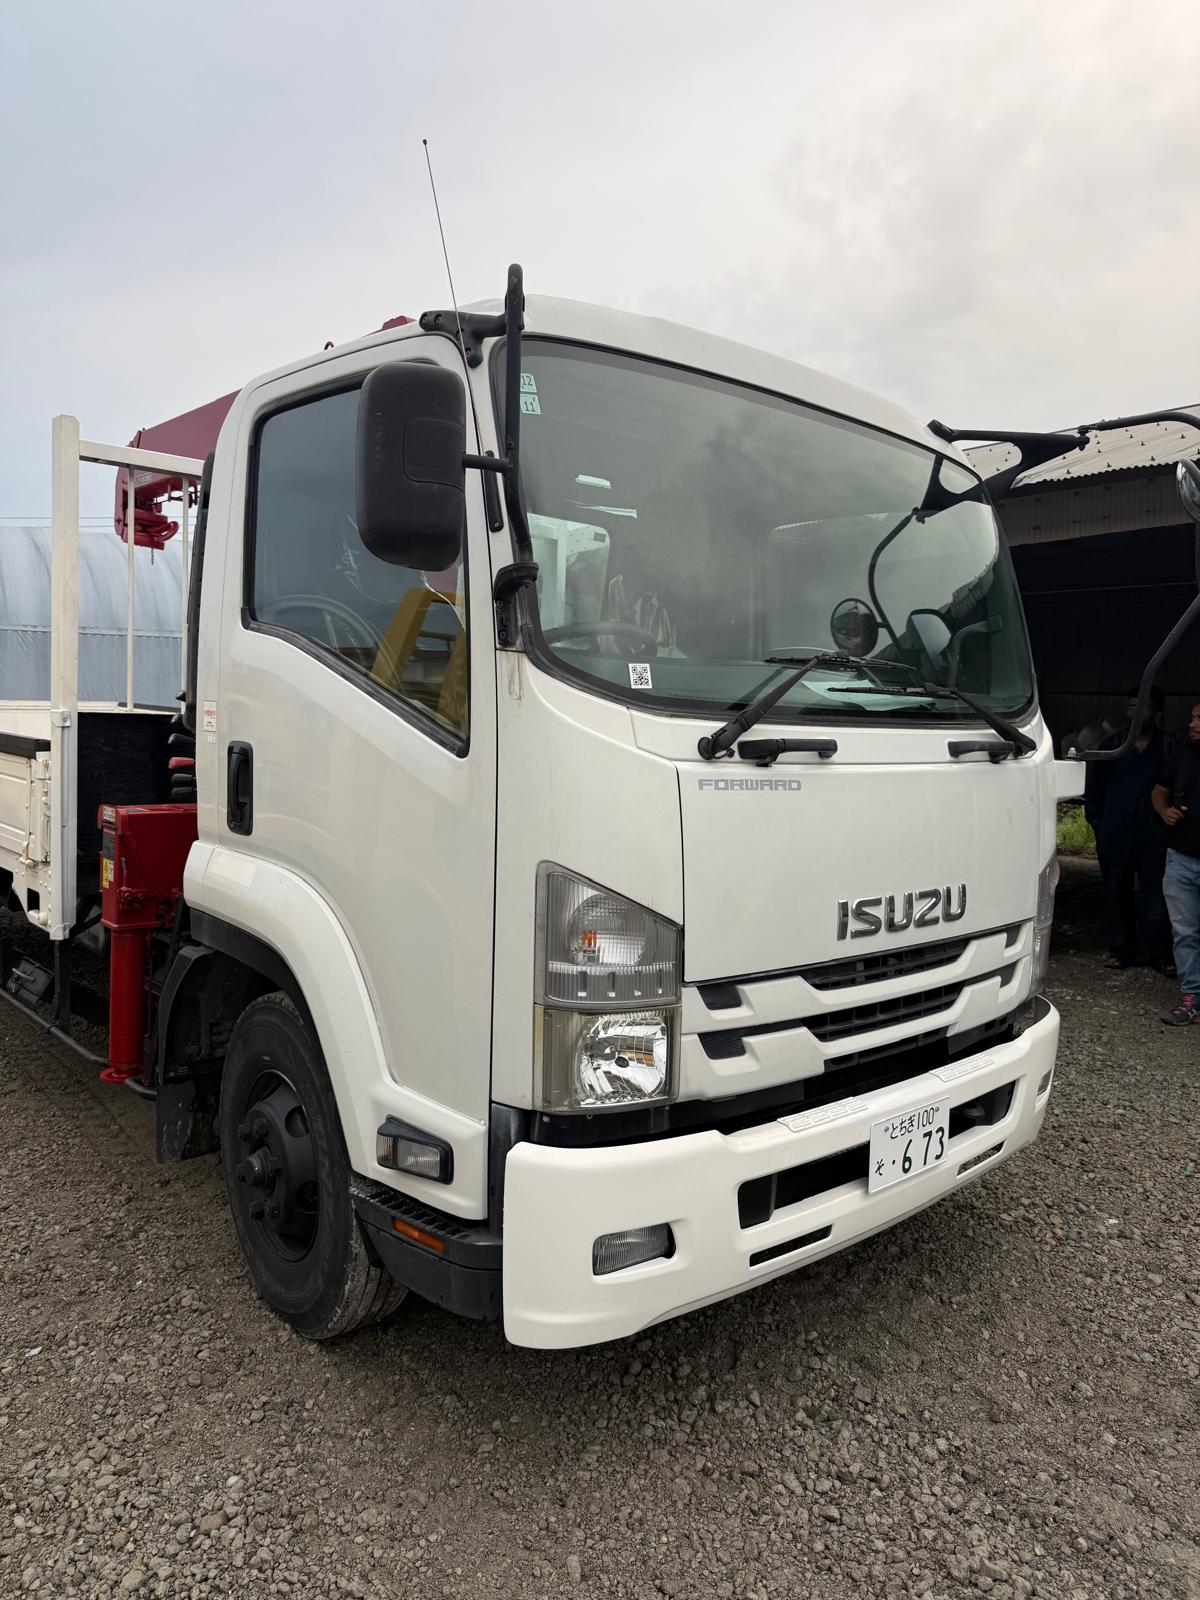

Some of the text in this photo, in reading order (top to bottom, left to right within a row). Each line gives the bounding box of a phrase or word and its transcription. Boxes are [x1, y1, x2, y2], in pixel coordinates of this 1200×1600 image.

[524, 401, 536, 412] 11
[698, 779, 802, 791] FORWARD
[837, 883, 967, 941] ISUZU
